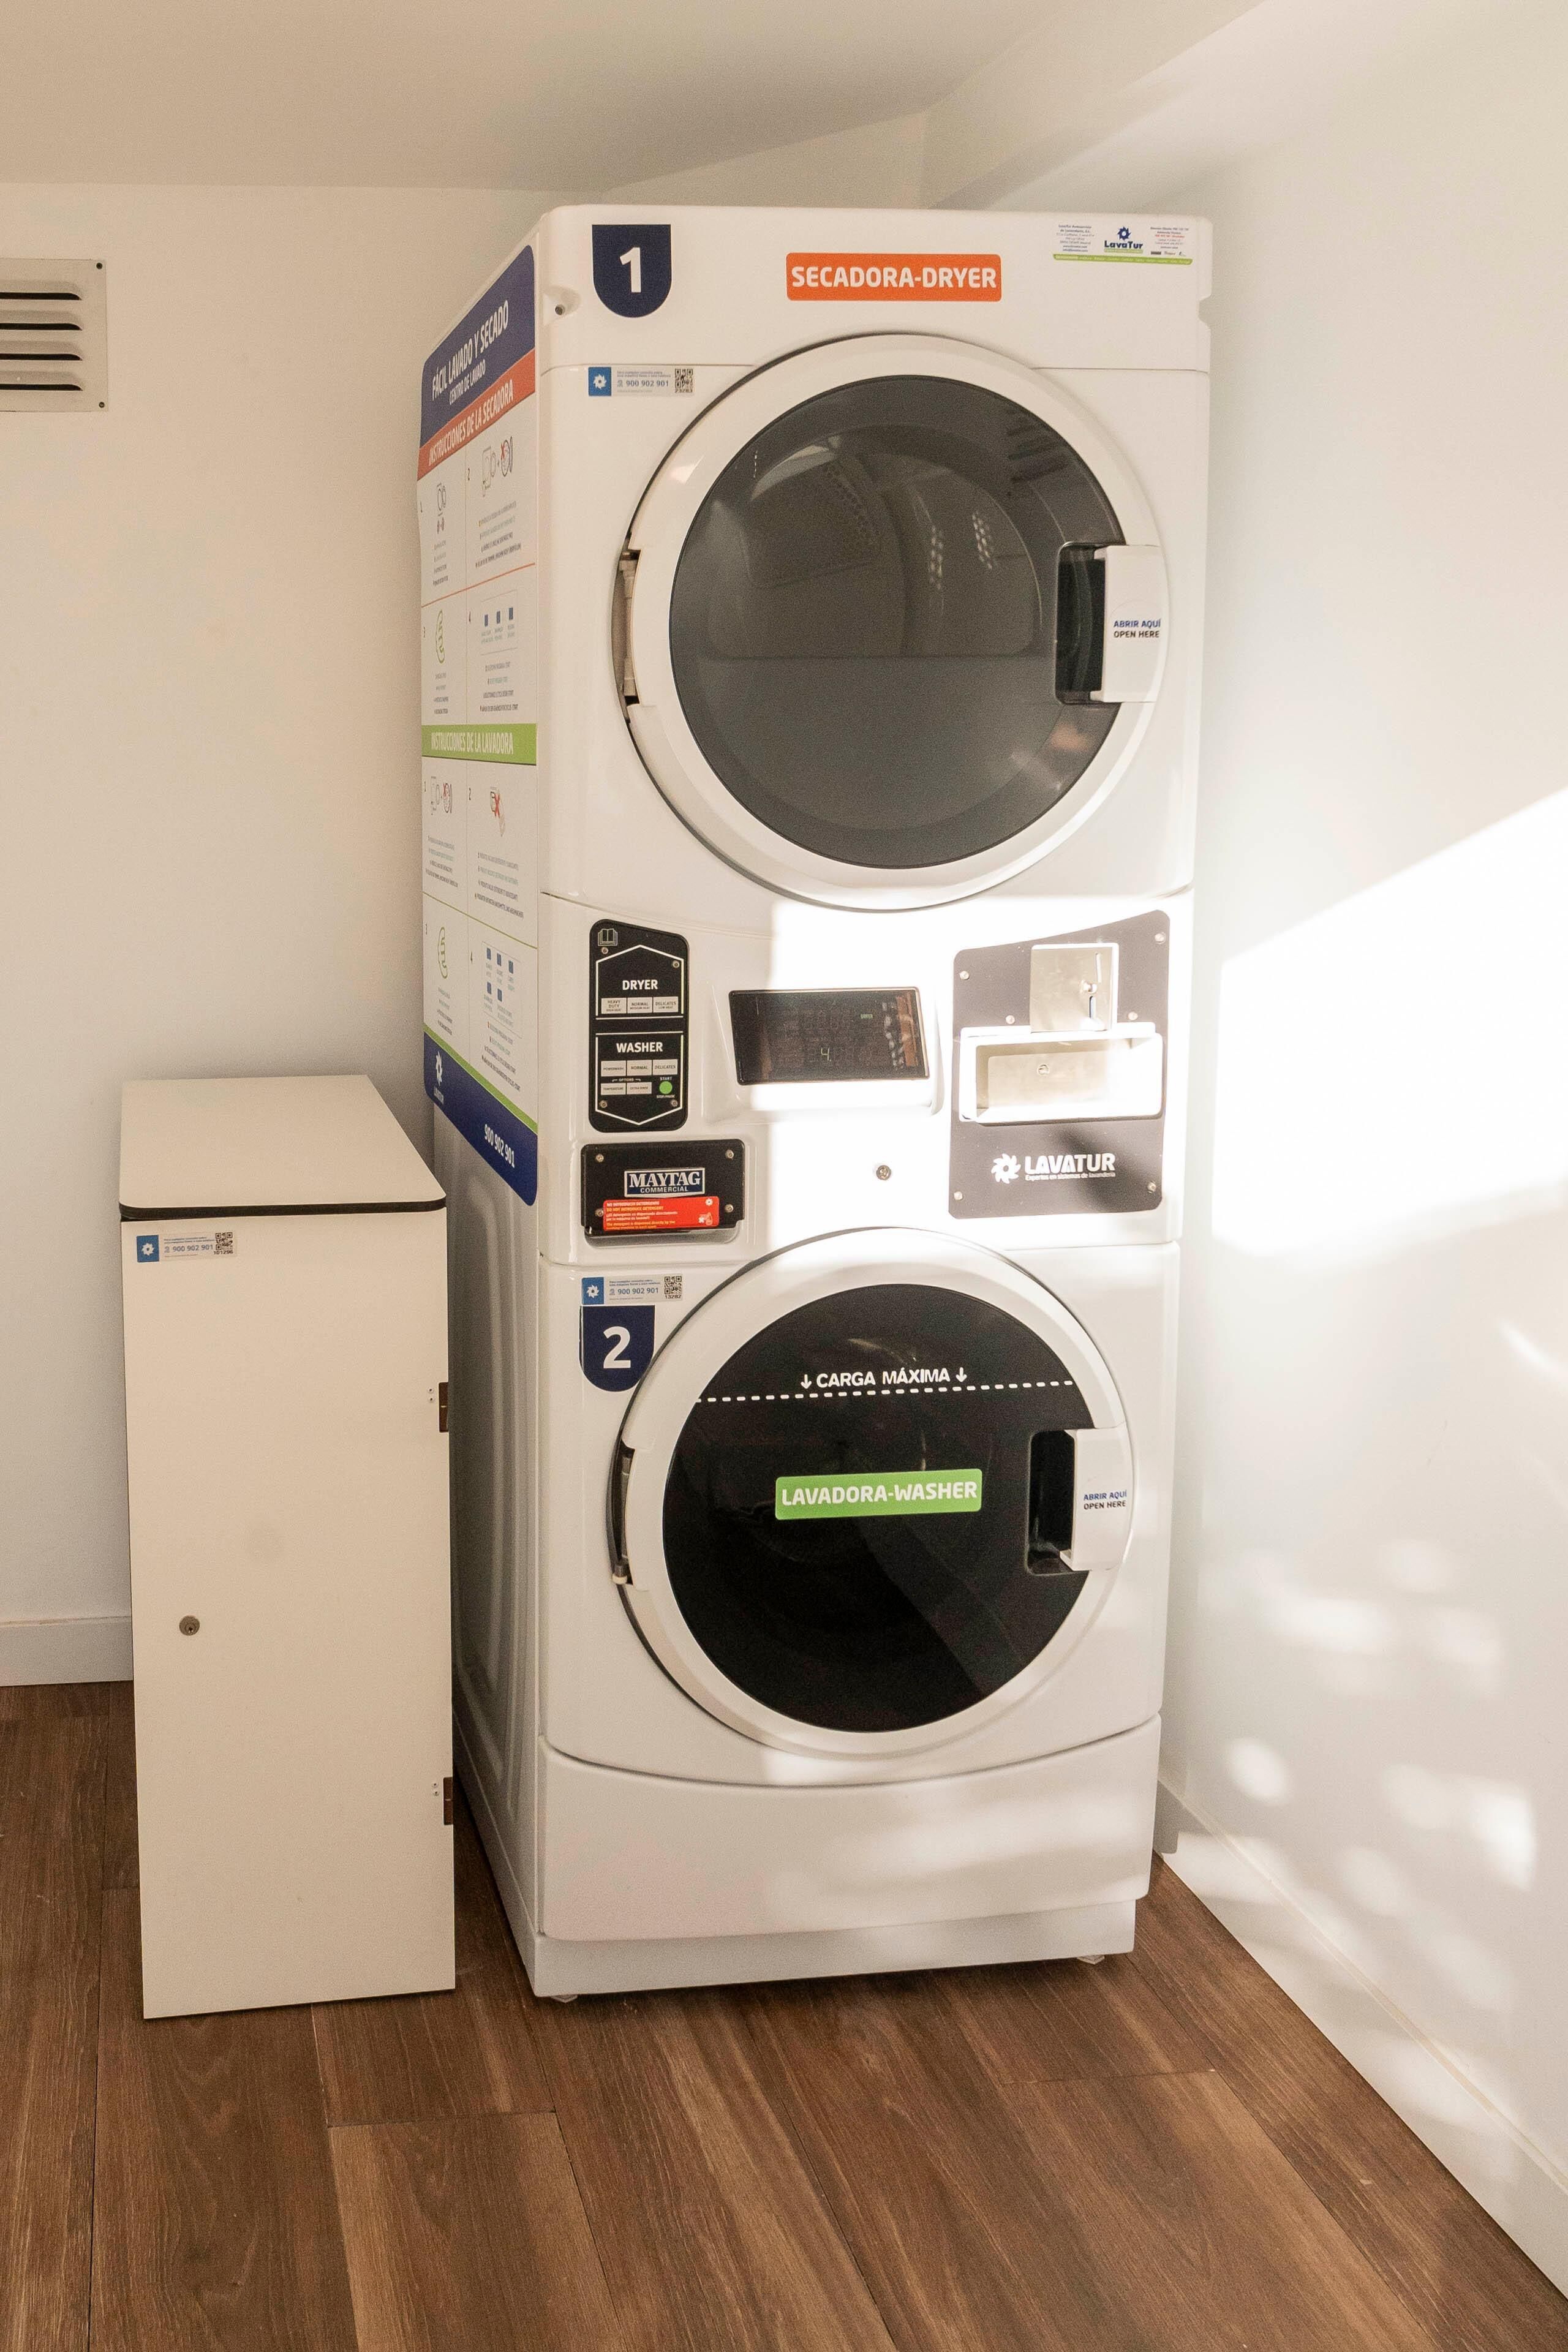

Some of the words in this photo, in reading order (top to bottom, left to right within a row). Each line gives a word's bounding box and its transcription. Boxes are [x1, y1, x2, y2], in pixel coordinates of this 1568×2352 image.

[1104, 239, 1144, 249] LavaTur
[619, 247, 642, 293] 1
[791, 266, 997, 289] SECADORA-DRYER
[431, 363, 448, 401] FÁCIL
[448, 337, 473, 386] LAVADO
[473, 332, 479, 359] Y
[480, 300, 510, 354] SECADO
[449, 383, 464, 405] CENTRO
[464, 378, 470, 394] DE
[470, 358, 486, 389] LAVADO
[428, 423, 466, 467] INSTRUCCIONES
[466, 415, 474, 436] DE
[474, 409, 482, 430] LA
[482, 379, 514, 424] SECADORA
[1113, 619, 1139, 628] ABRIR
[1140, 618, 1161, 628] AQUÍ
[1138, 630, 1160, 638] HERE
[431, 731, 466, 753] INSTRUCCIONES
[466, 732, 474, 753] DE
[474, 732, 481, 754] LA
[481, 733, 514, 755] LAVADORA
[622, 979, 658, 990] DRYER
[616, 1042, 663, 1053] WASHER
[484, 1123, 494, 1147] 900
[494, 1134, 504, 1157] 902
[505, 1145, 515, 1169] 901
[1025, 1153, 1116, 1174] LAVATUR
[628, 1171, 701, 1188] MAYTAG
[603, 1325, 631, 1370] 2
[816, 1371, 875, 1388] CARGA
[882, 1366, 951, 1385] MÁXIMA
[781, 1480, 978, 1507] LAVADORA-WASHER
[1106, 1500, 1127, 1509] HERE
[1109, 1489, 1128, 1500] AQUÍ
